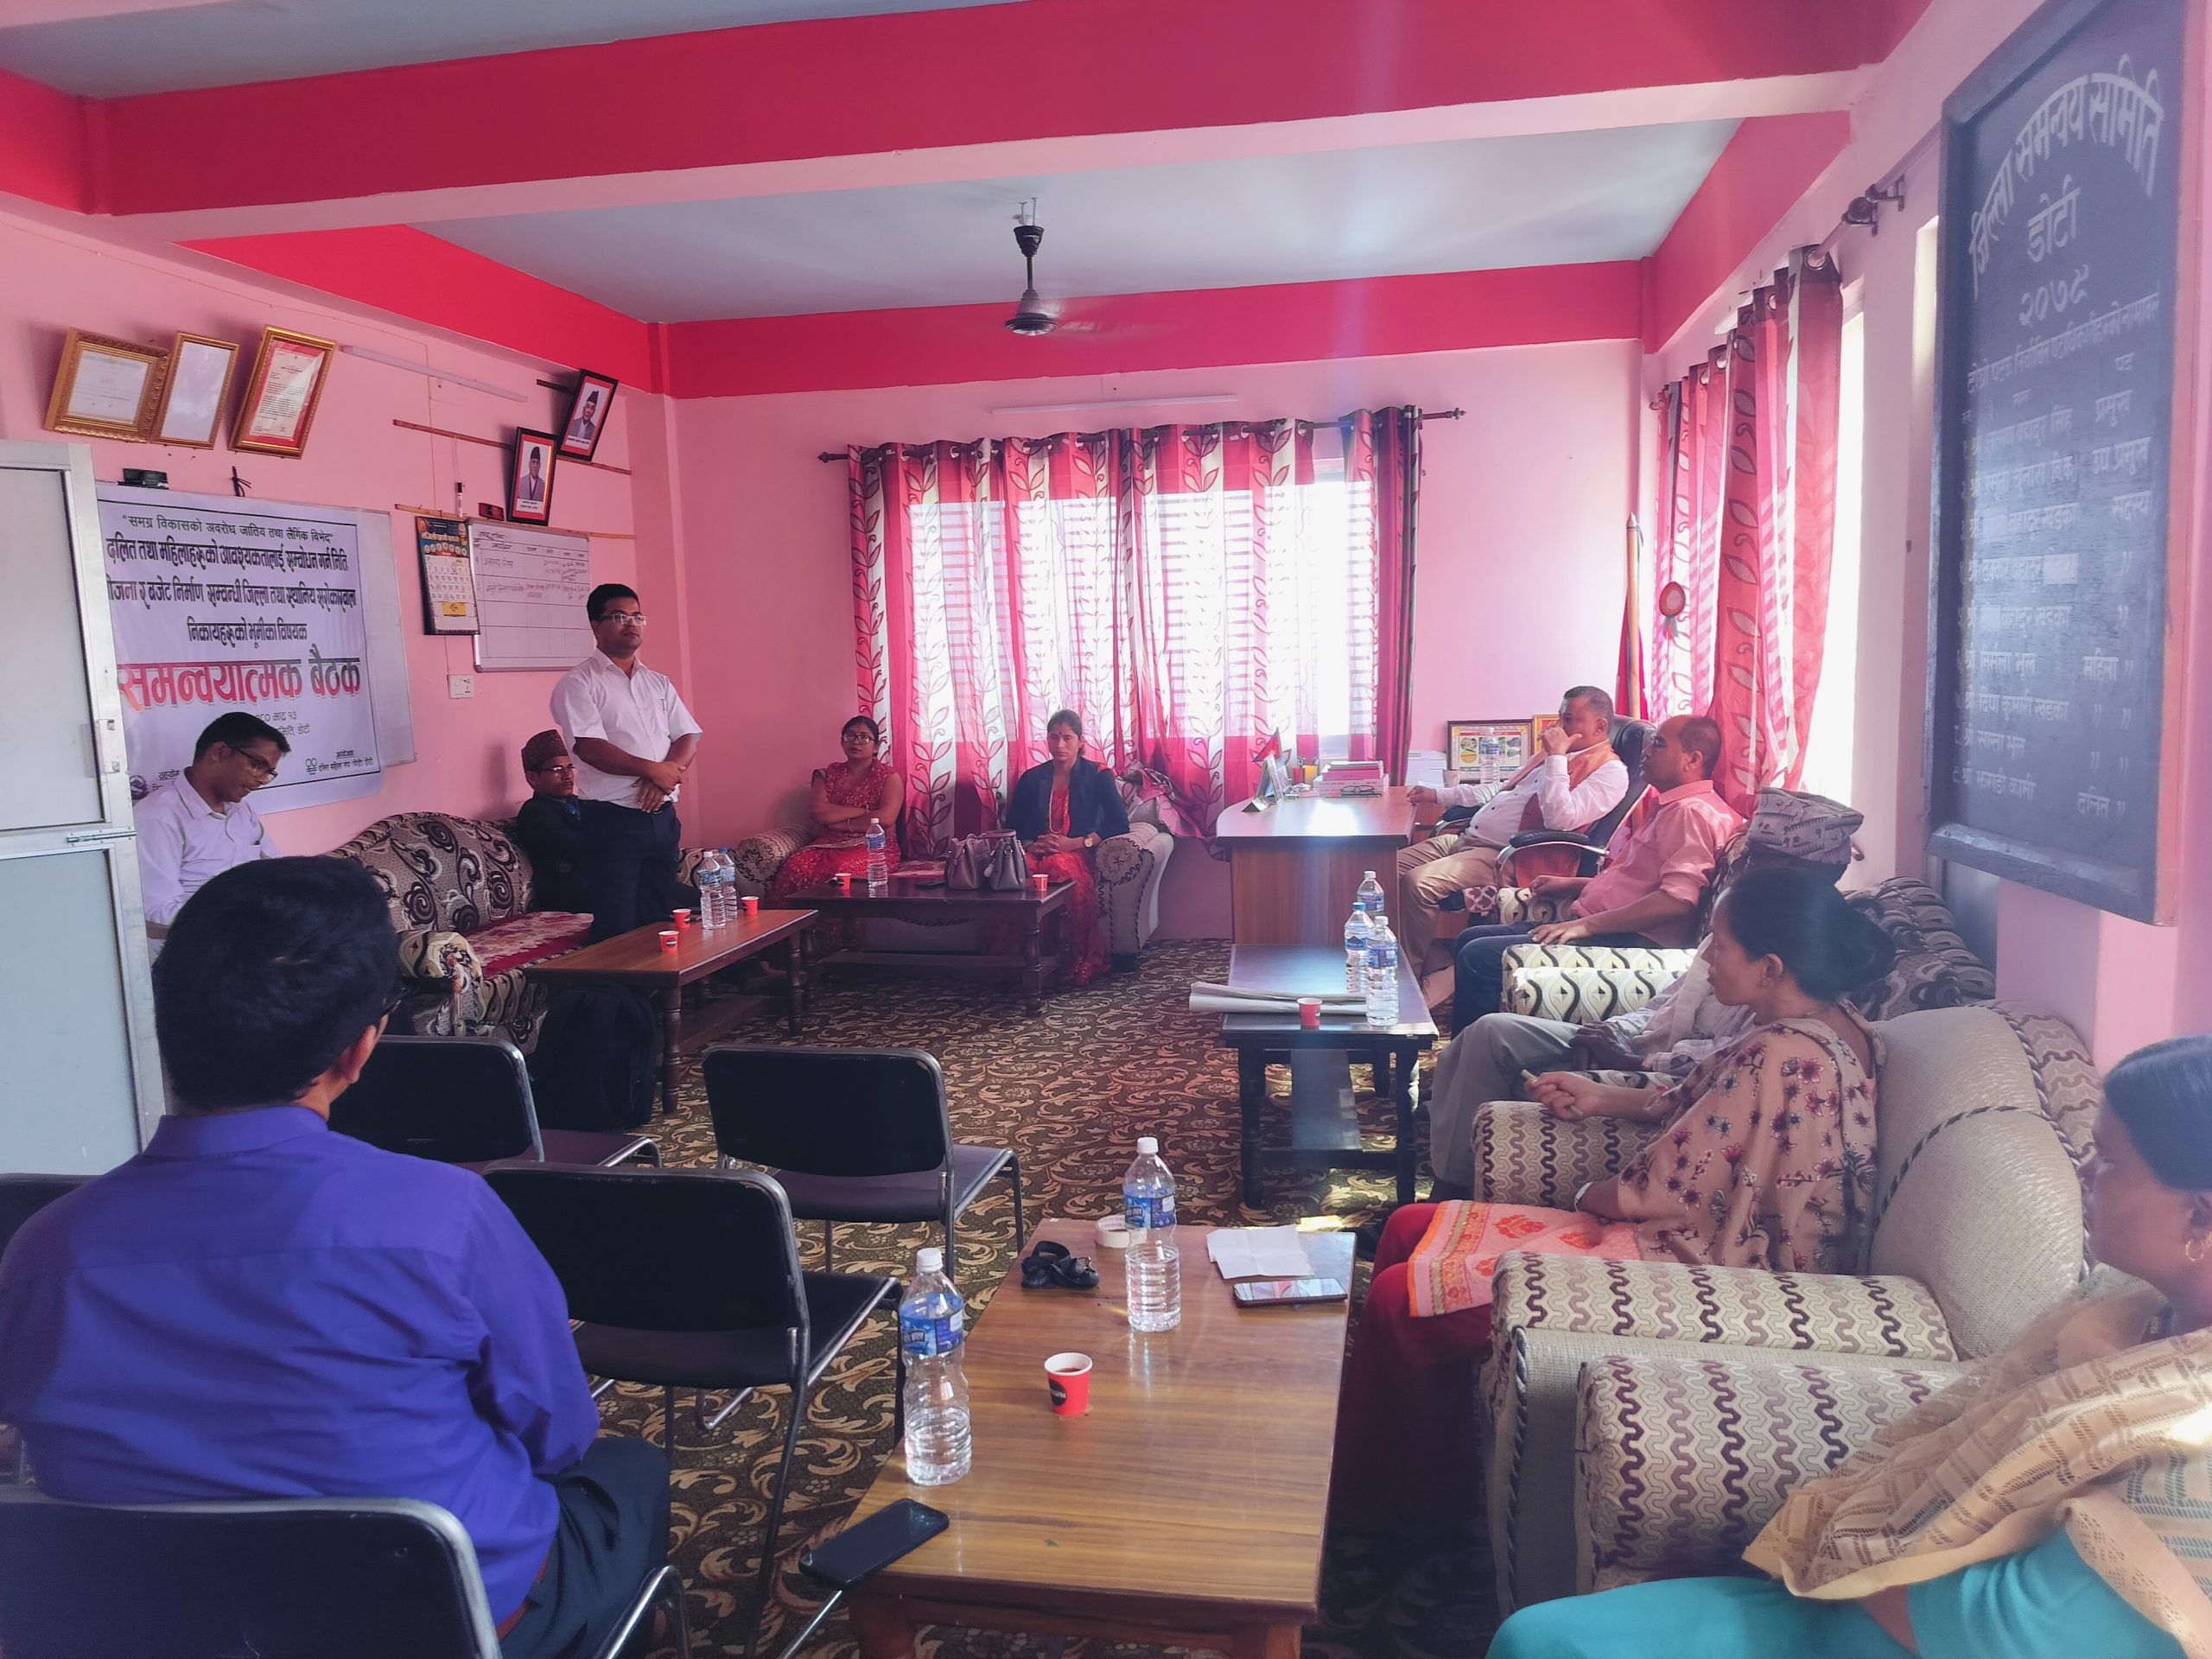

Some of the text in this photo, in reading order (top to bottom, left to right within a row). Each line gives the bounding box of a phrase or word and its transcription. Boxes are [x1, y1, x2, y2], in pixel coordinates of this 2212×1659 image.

[2014, 74, 2088, 180] समन्वय
[2088, 53, 2165, 200] समिति
[2027, 174, 2082, 263] डोटी
[2094, 389, 2134, 428] प्रमुख
[2113, 435, 2152, 476] प्रमुख
[156, 514, 203, 532] विकासको
[206, 520, 237, 536] अवरोध
[267, 527, 284, 539] तथा
[105, 531, 137, 565] दलित
[137, 539, 159, 562] तथा
[317, 546, 333, 570] गर्न
[171, 575, 205, 603] निर्माण
[241, 578, 270, 607] जिल्ला
[269, 585, 287, 606] तथा
[276, 616, 308, 641] विषयक
[116, 643, 361, 712] समन्वयात्मक बैठक
